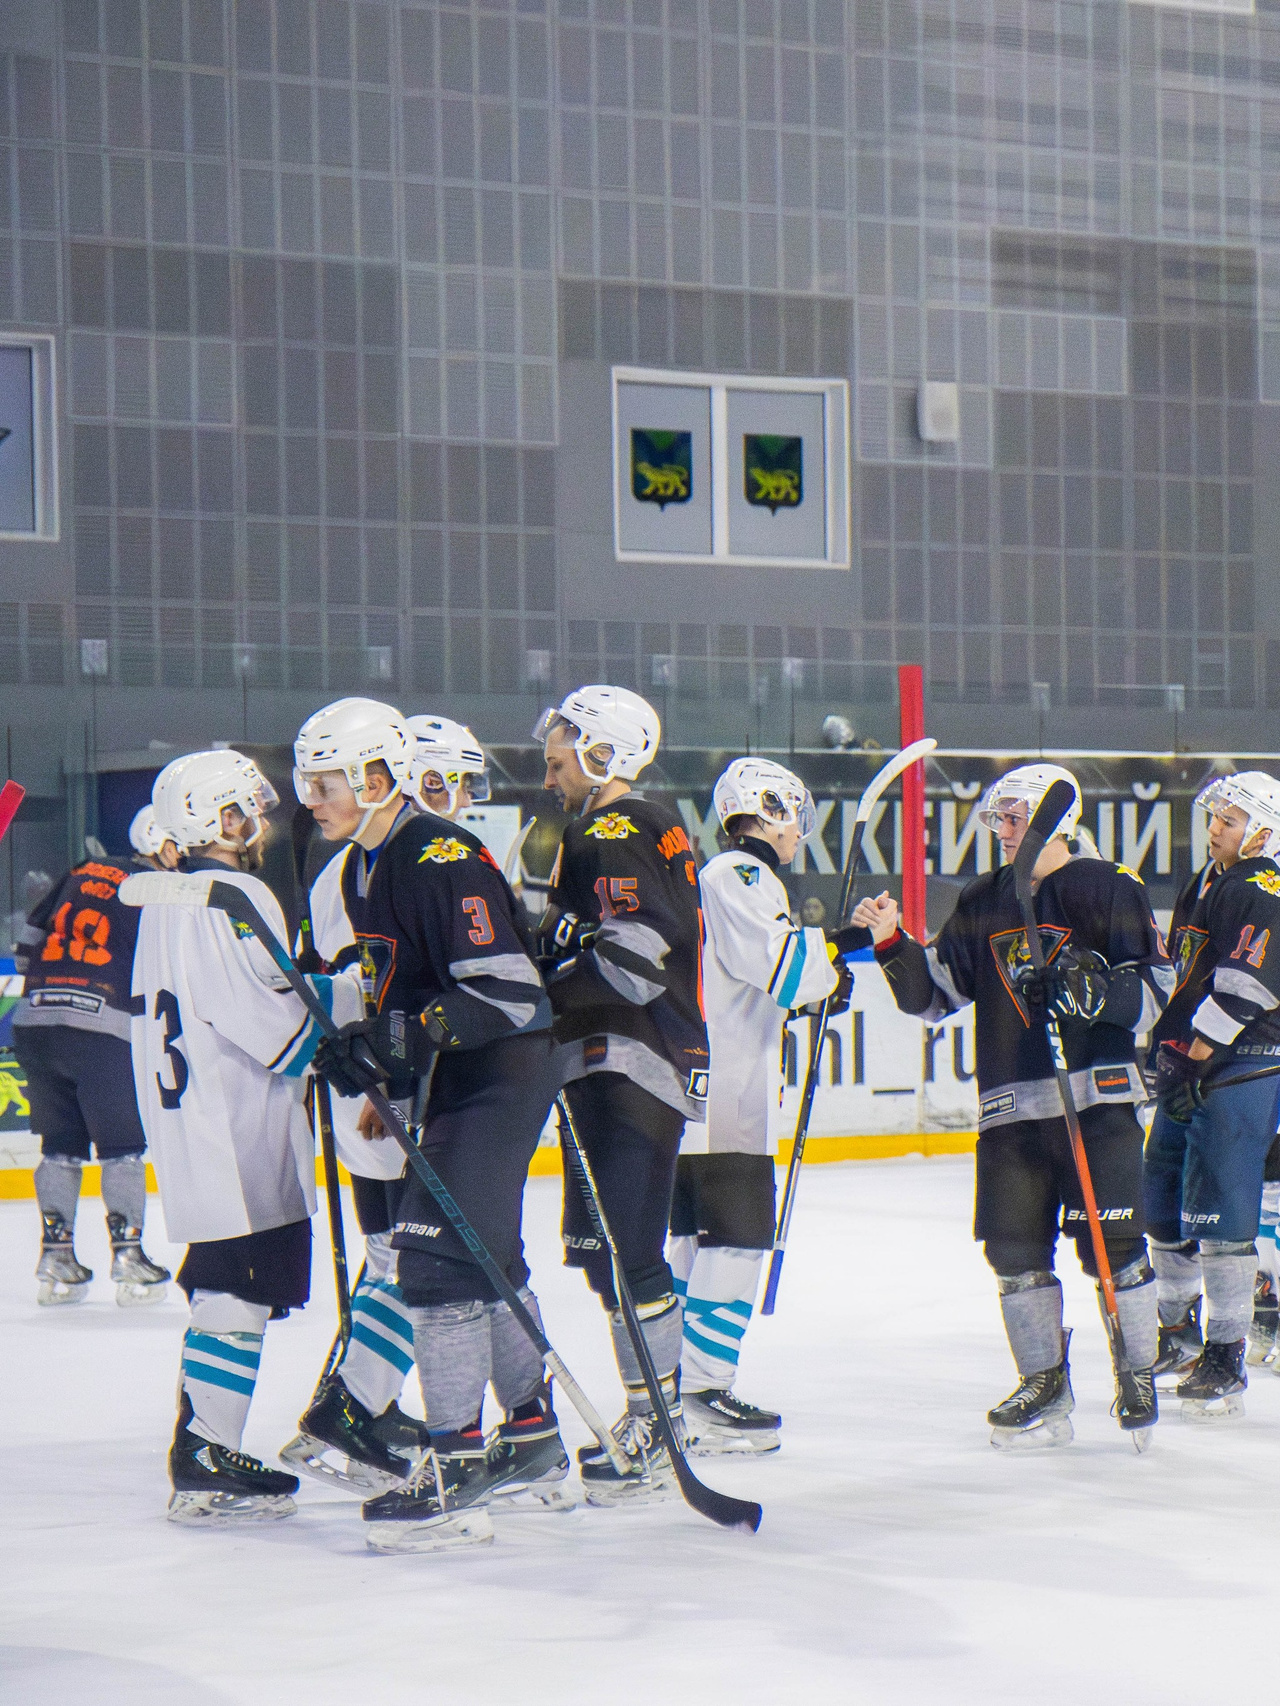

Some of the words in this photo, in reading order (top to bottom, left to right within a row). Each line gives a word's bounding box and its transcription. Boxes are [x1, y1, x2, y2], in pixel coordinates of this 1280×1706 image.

[359, 744, 384, 757] CCM
[213, 788, 237, 802] CCM
[462, 896, 496, 946] 3
[594, 877, 640, 921] 15
[1230, 924, 1271, 969] 14
